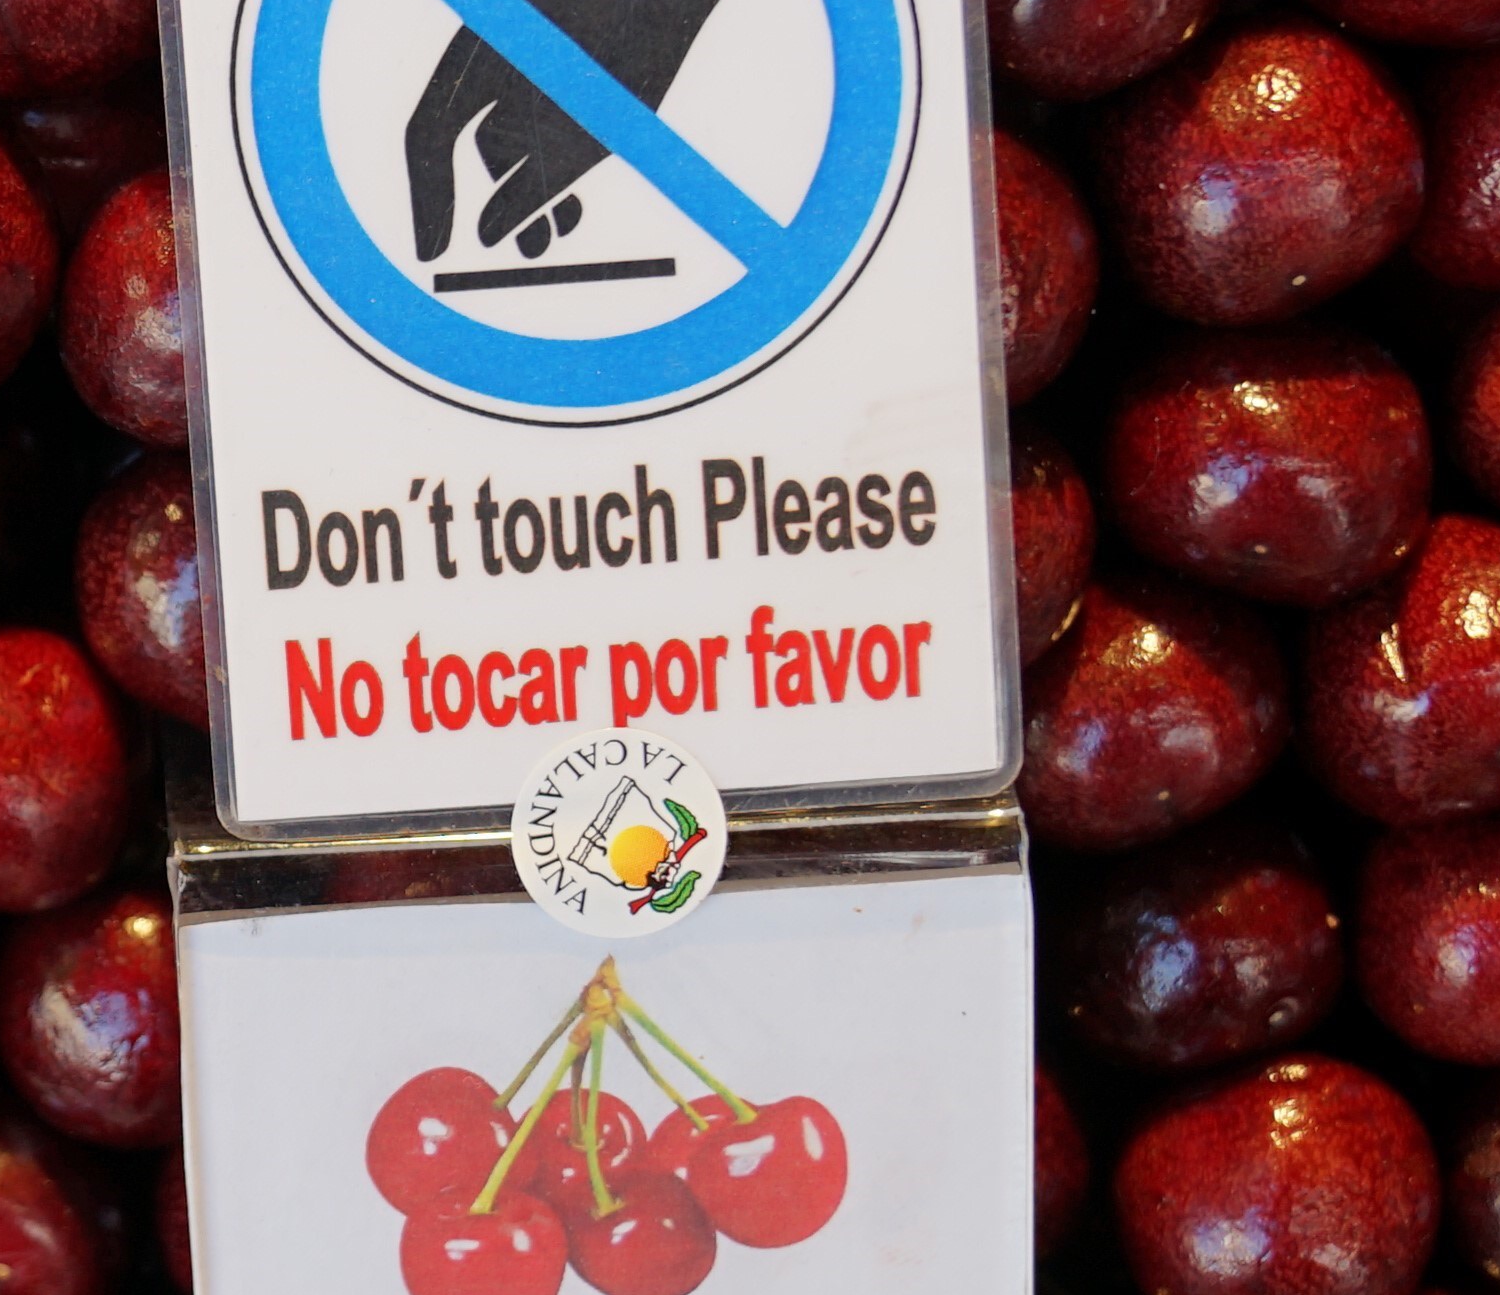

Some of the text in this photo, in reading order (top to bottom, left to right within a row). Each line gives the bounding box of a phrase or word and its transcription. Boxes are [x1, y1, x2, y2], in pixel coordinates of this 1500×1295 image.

[474, 464, 678, 577] touch
[701, 455, 937, 561] Please
[284, 604, 932, 741] No tocar por favor
[528, 739, 688, 915] LA CALANDINA
